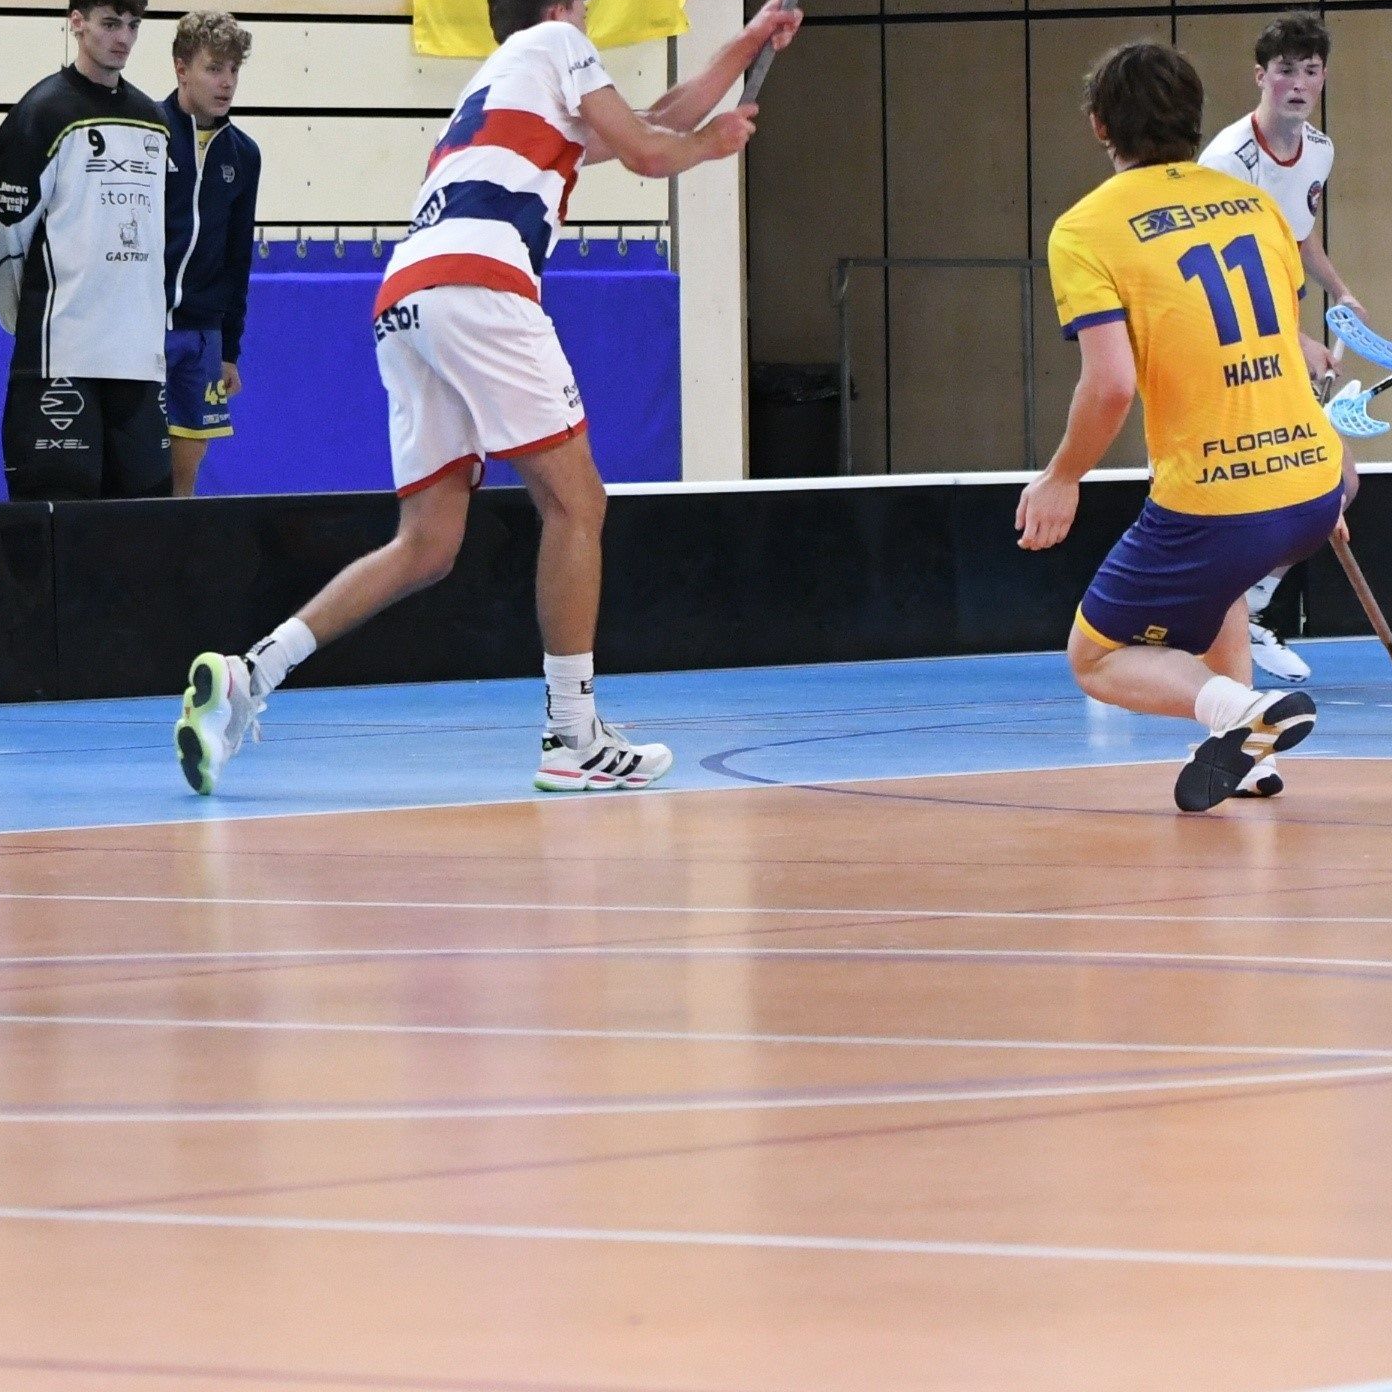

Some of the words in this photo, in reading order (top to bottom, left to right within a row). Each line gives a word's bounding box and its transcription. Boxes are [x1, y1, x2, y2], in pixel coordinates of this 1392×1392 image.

[87, 128, 106, 157] 9
[85, 158, 157, 175] EXEL
[1176, 233, 1280, 347] 11
[1222, 354, 1283, 389] HÁJEK
[34, 438, 90, 450] EXEL
[1202, 422, 1318, 458] FLORBAL
[1195, 445, 1328, 485] JABLONEC
